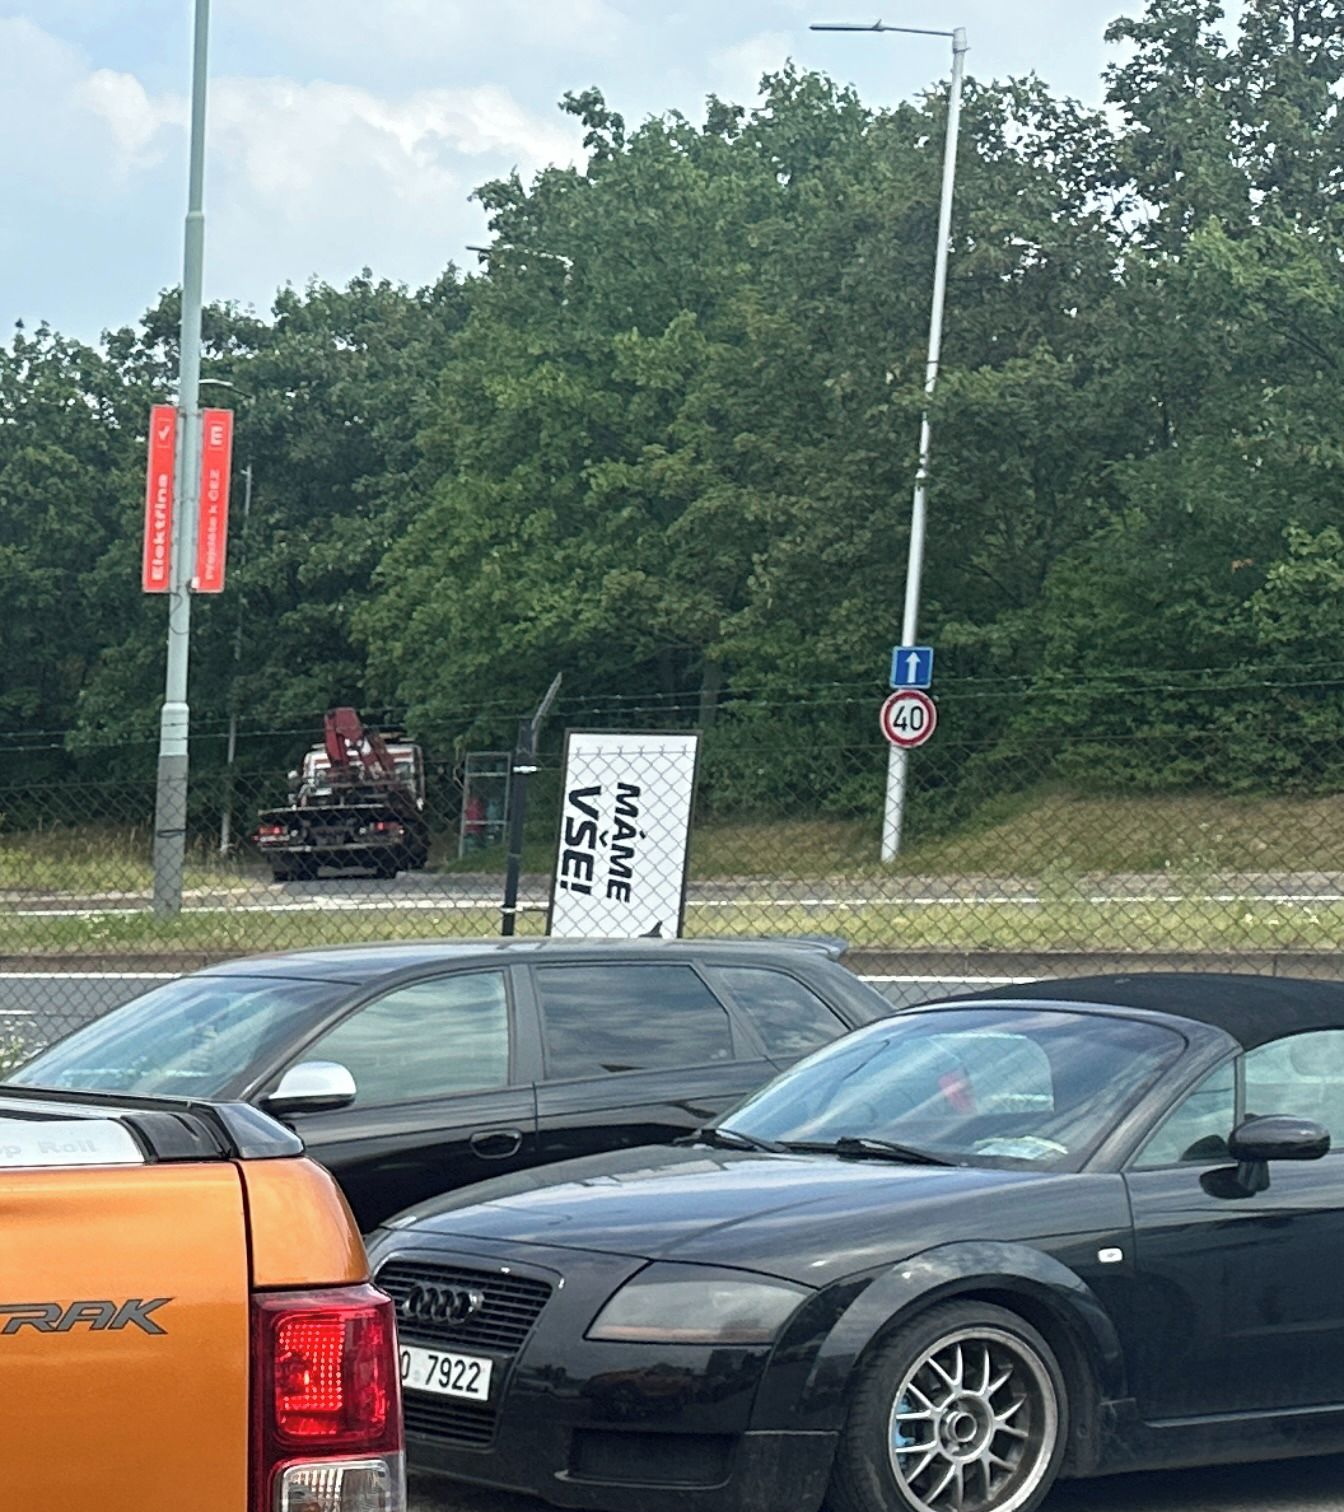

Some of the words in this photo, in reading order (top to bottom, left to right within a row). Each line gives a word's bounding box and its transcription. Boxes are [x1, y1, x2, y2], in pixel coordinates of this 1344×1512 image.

[893, 706, 924, 731] 40
[560, 785, 610, 896] VŠE!
[606, 782, 647, 903] MÁME
[37, 1139, 97, 1155] Roll
[425, 1355, 482, 1393] 7922
